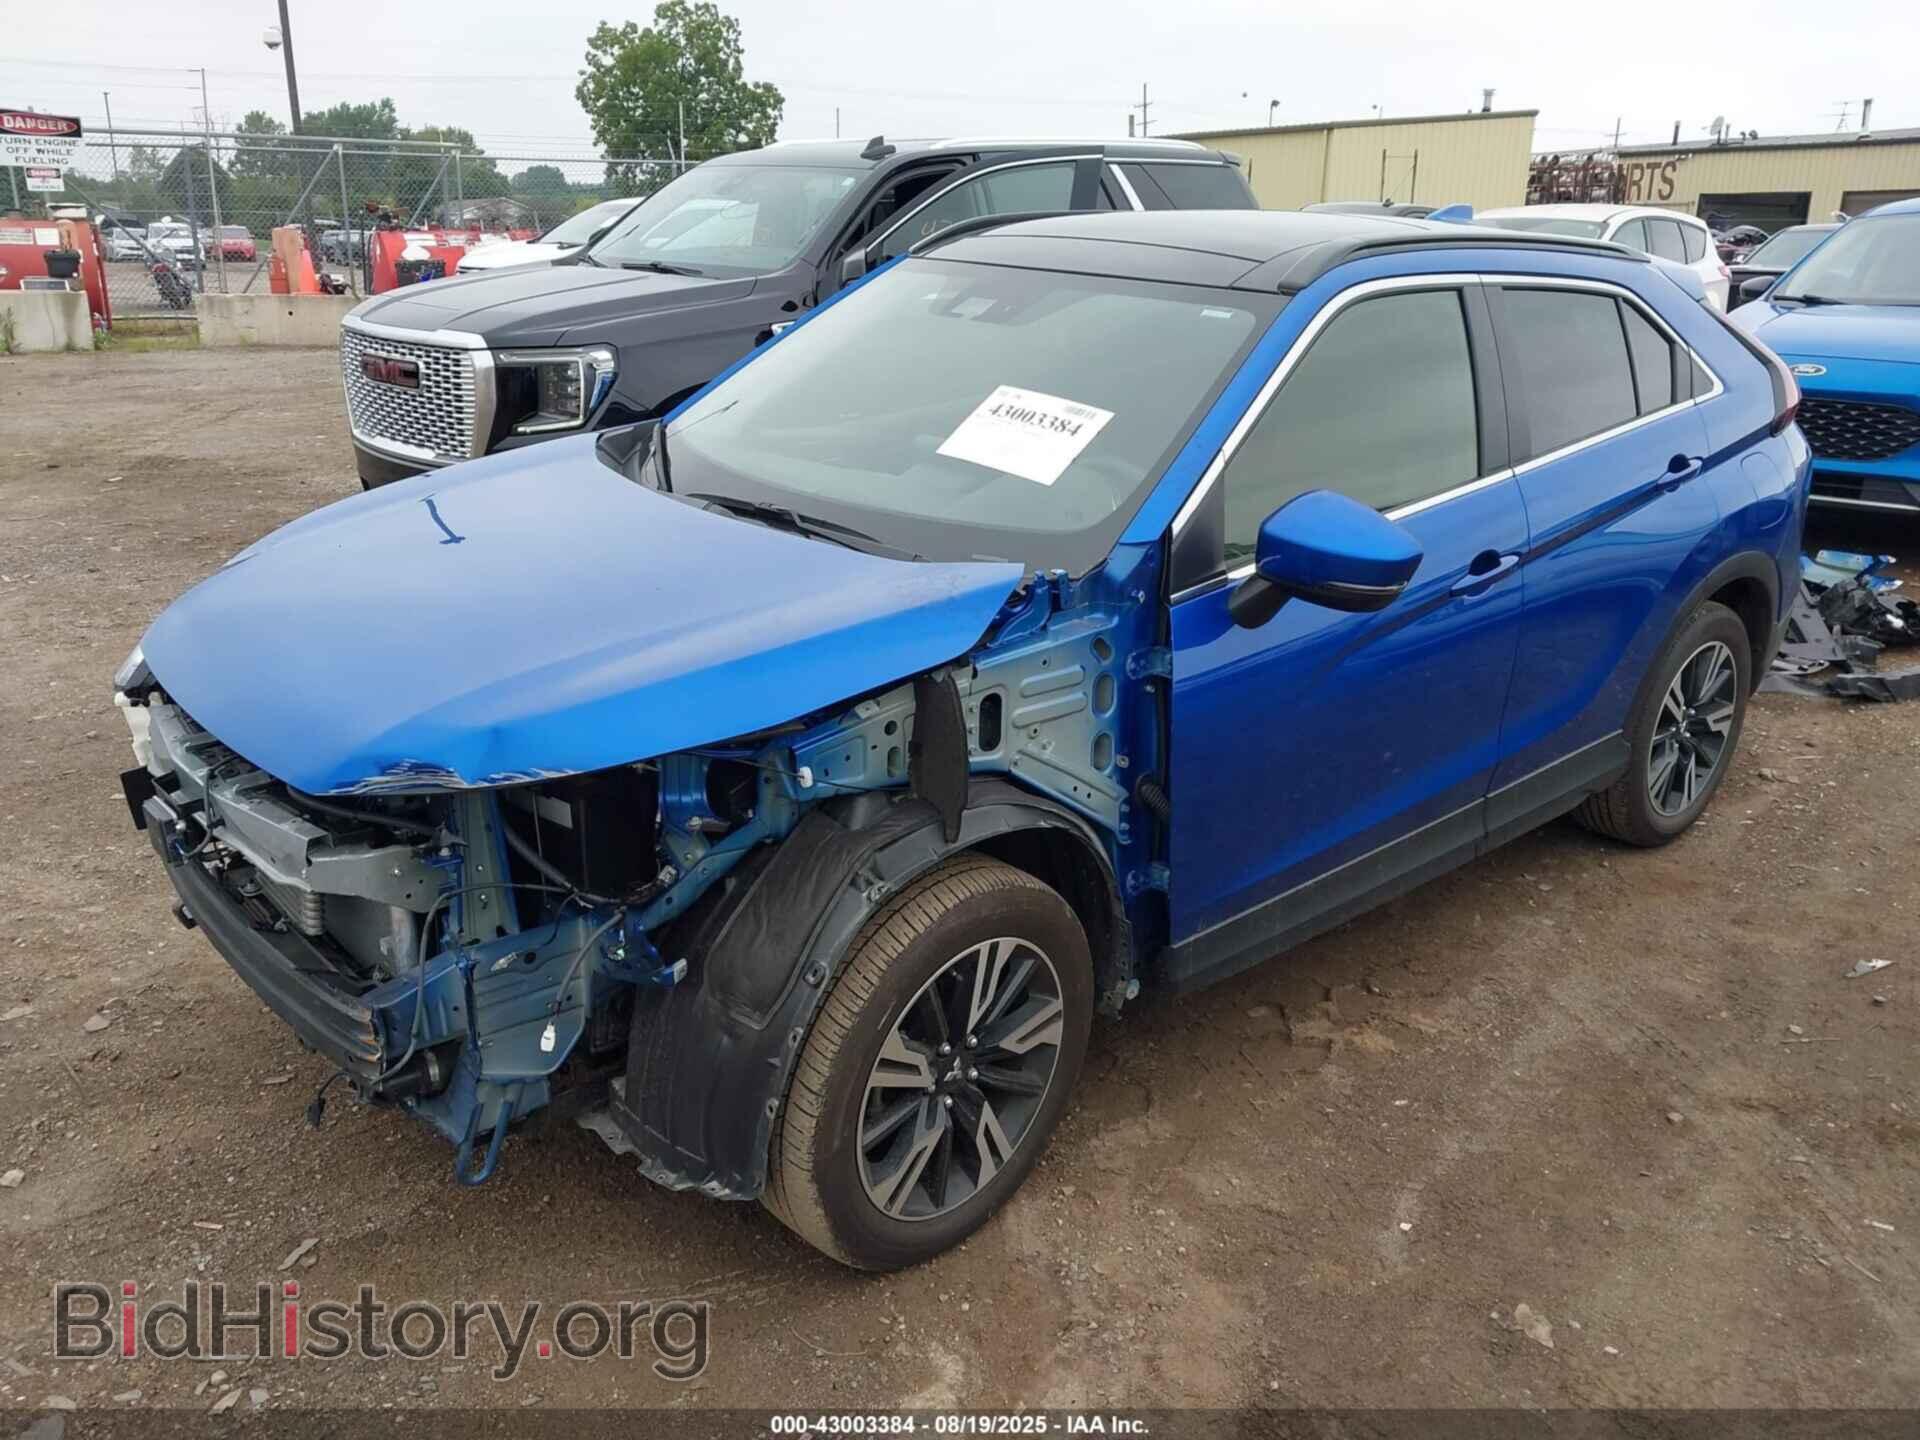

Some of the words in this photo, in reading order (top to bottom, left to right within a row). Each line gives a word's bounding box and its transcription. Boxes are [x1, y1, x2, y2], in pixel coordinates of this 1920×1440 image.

[3, 115, 68, 131] DANGER
[35, 138, 79, 147] ENGINE
[6, 146, 31, 154] OFF
[35, 147, 74, 156] WHILE
[15, 156, 69, 165] FUELING
[988, 403, 1084, 437] 43003384
